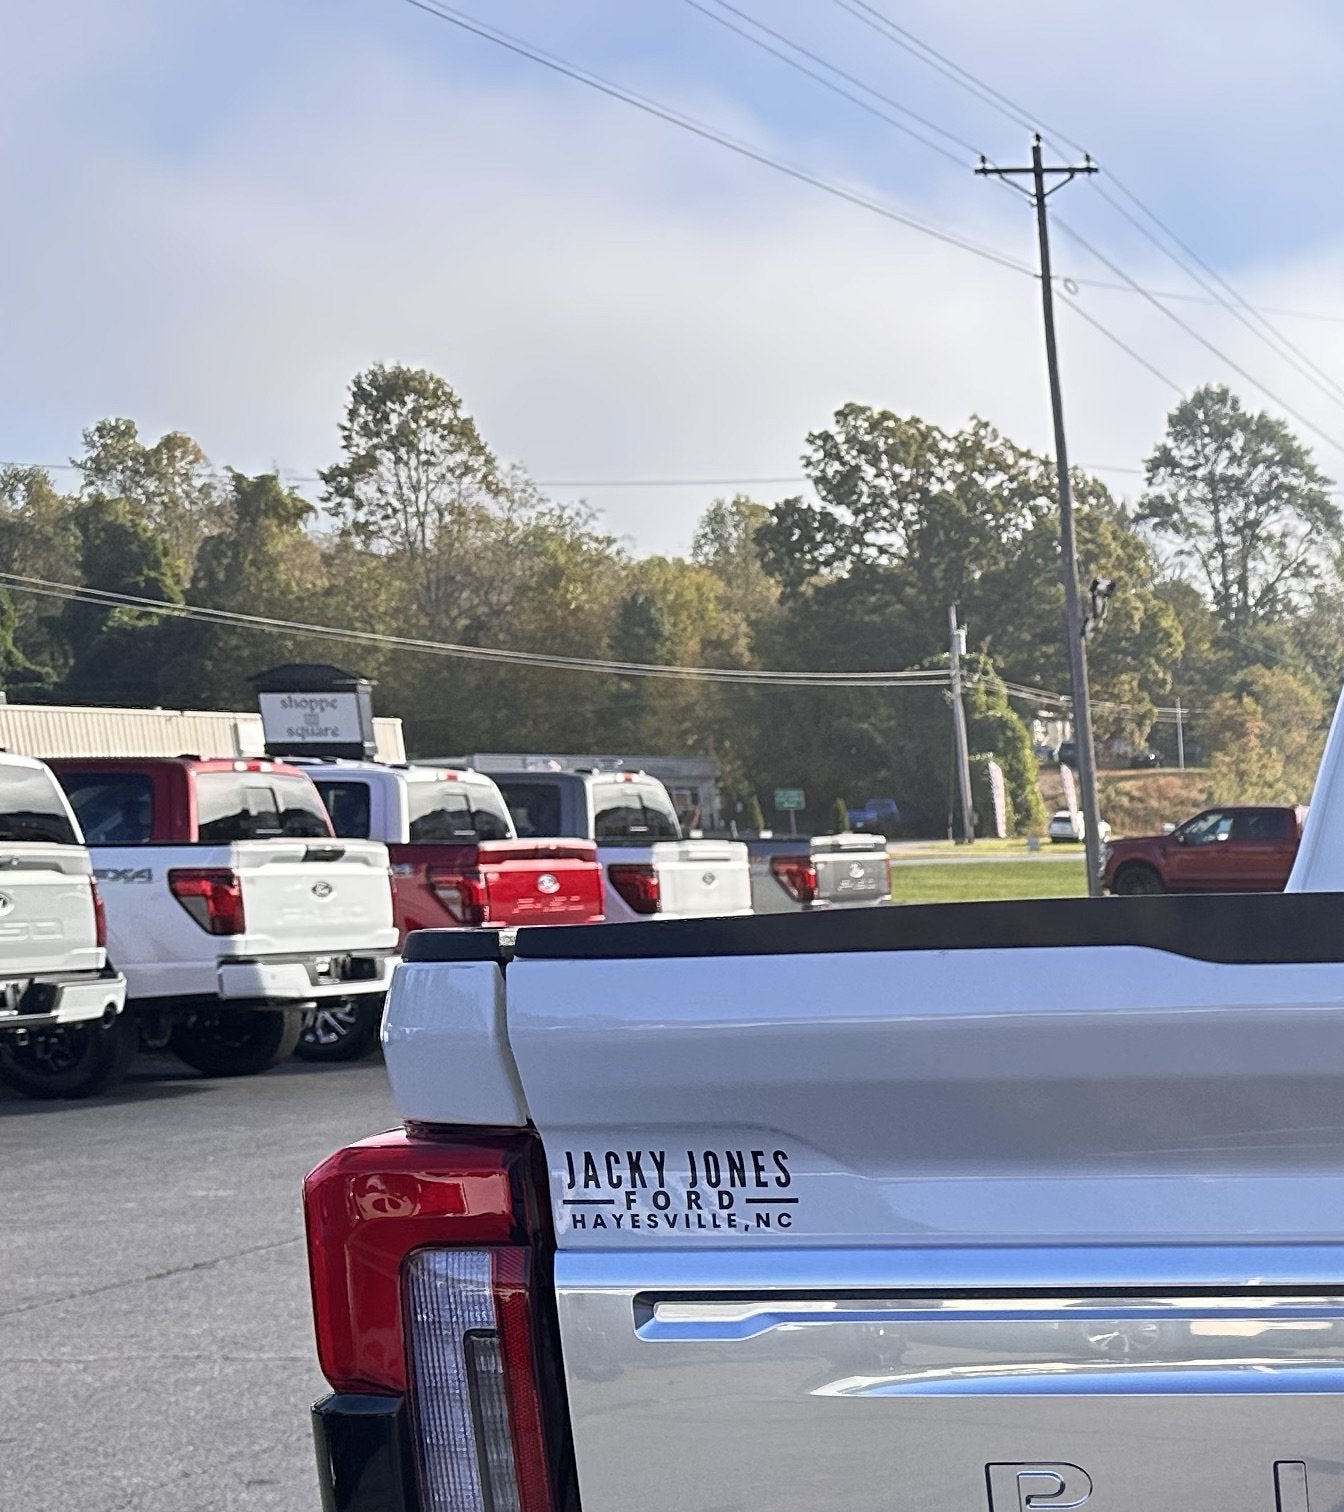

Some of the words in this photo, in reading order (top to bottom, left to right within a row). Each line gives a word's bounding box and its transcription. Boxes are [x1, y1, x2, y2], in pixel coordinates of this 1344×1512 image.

[280, 695, 338, 713] shoppe
[286, 725, 340, 740] square
[565, 1151, 665, 1189] JACKY
[687, 1150, 791, 1188] JONES
[625, 1190, 734, 1210] FORD
